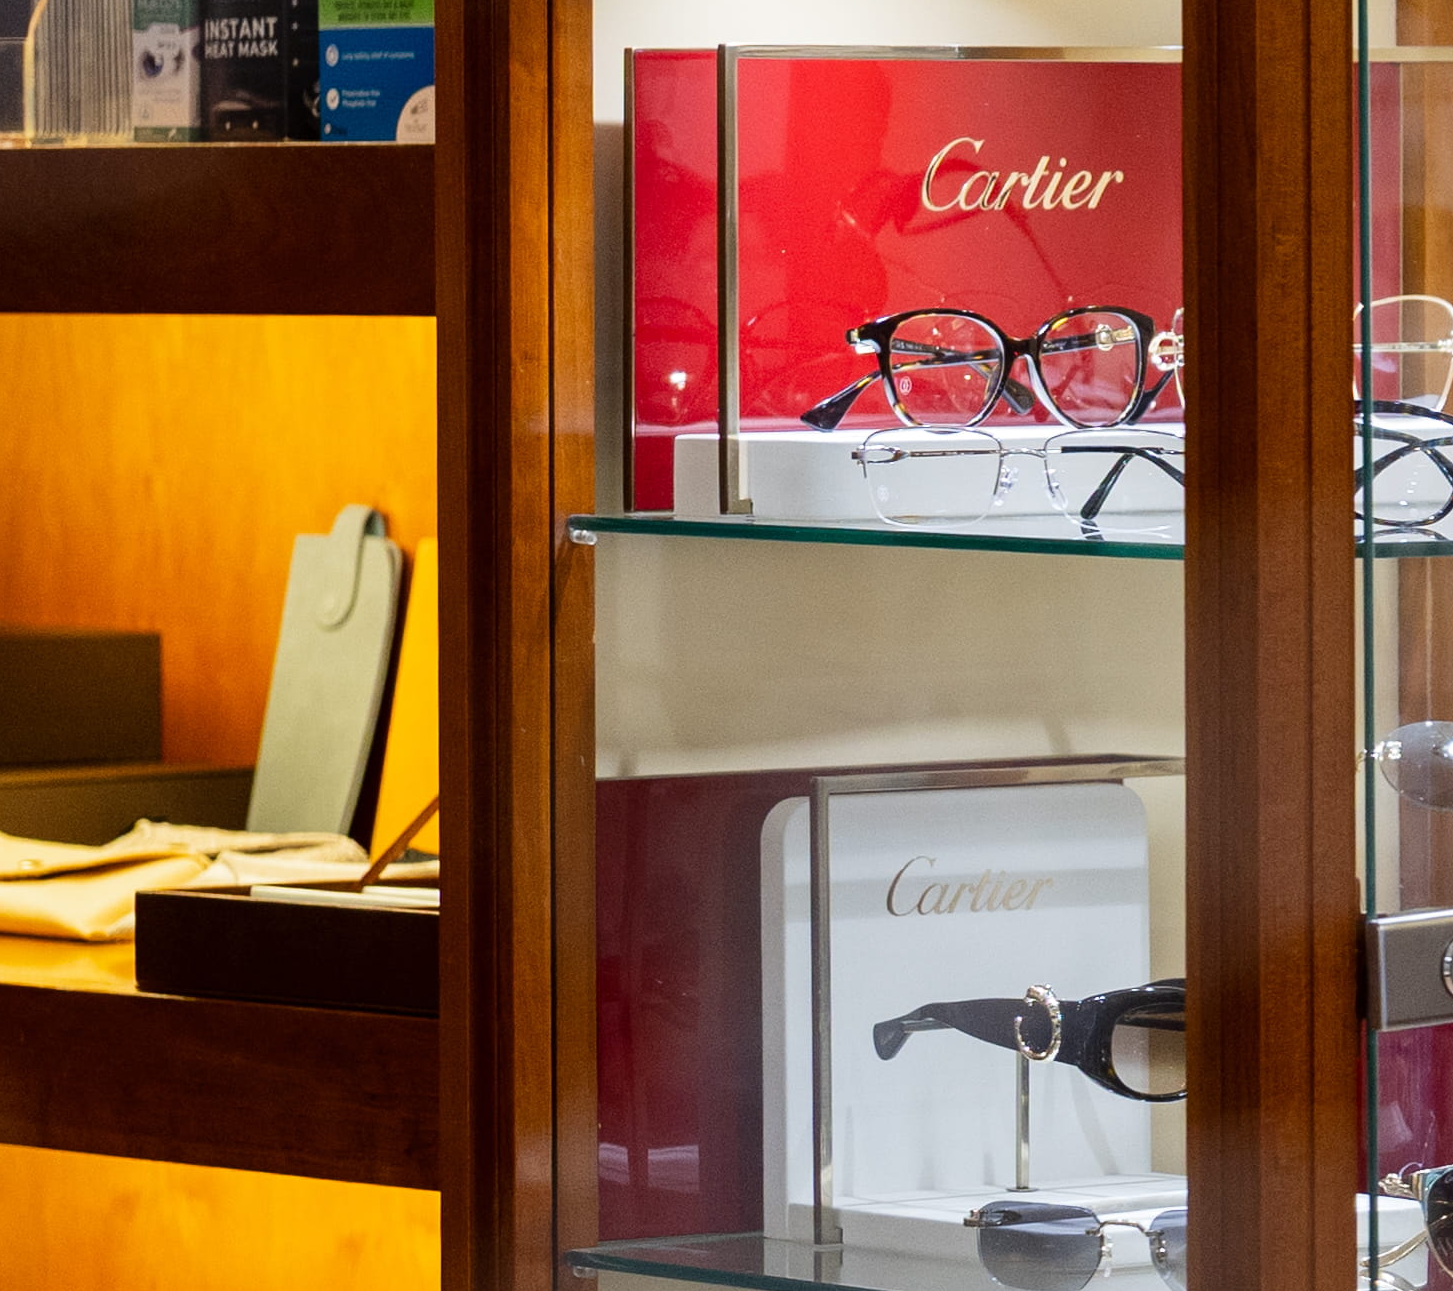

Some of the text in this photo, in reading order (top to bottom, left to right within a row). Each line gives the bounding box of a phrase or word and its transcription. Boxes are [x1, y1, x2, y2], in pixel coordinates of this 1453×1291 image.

[204, 16, 279, 41] INSTANT
[204, 38, 279, 59] HEAT MASK
[922, 137, 1125, 212] Cartier
[885, 855, 1054, 918] Cartier
